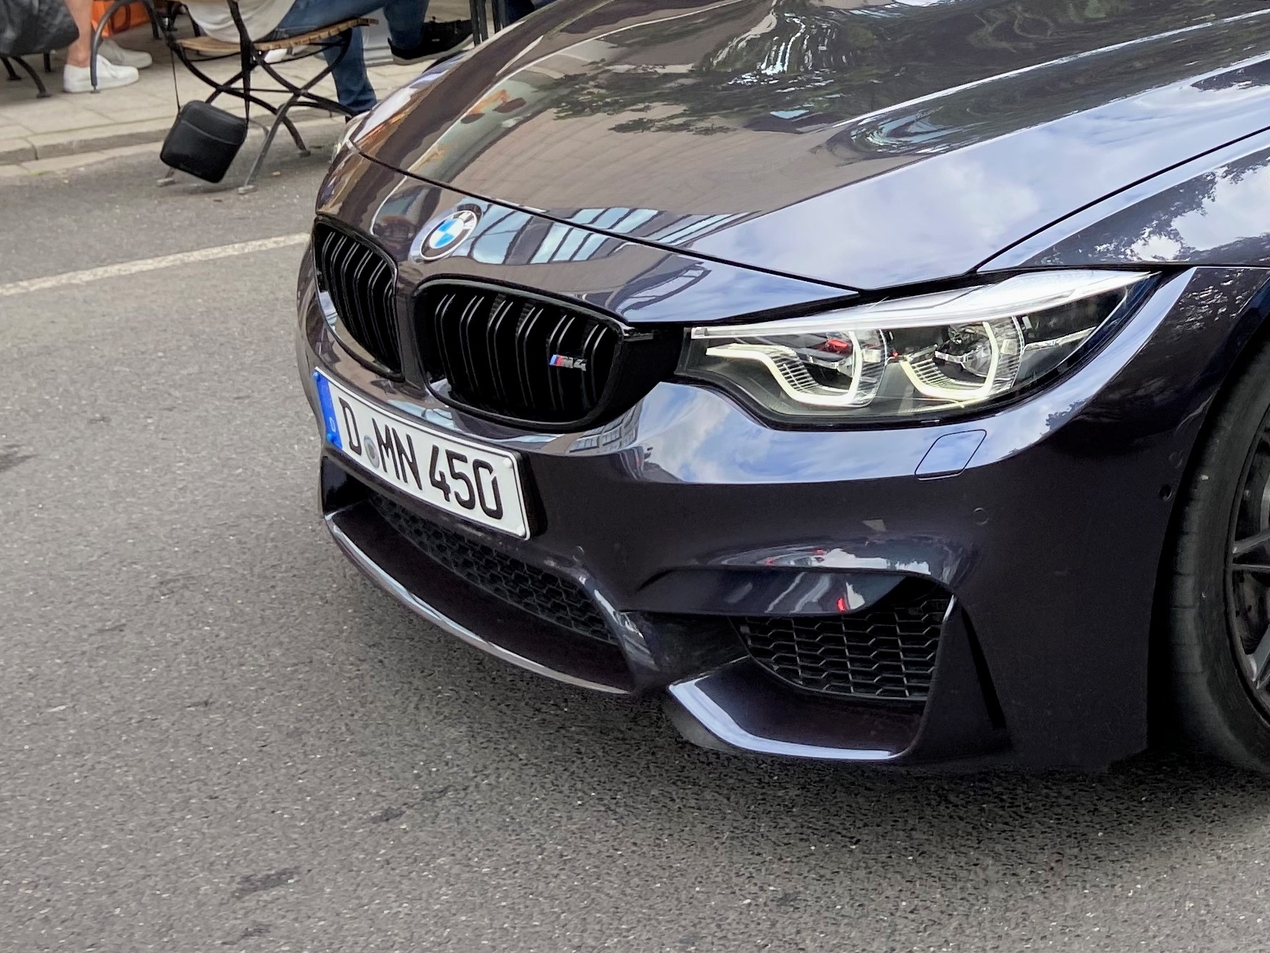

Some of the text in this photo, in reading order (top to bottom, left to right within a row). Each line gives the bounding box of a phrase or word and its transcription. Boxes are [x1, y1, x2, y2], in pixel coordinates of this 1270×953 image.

[338, 396, 504, 520] D MN 450
